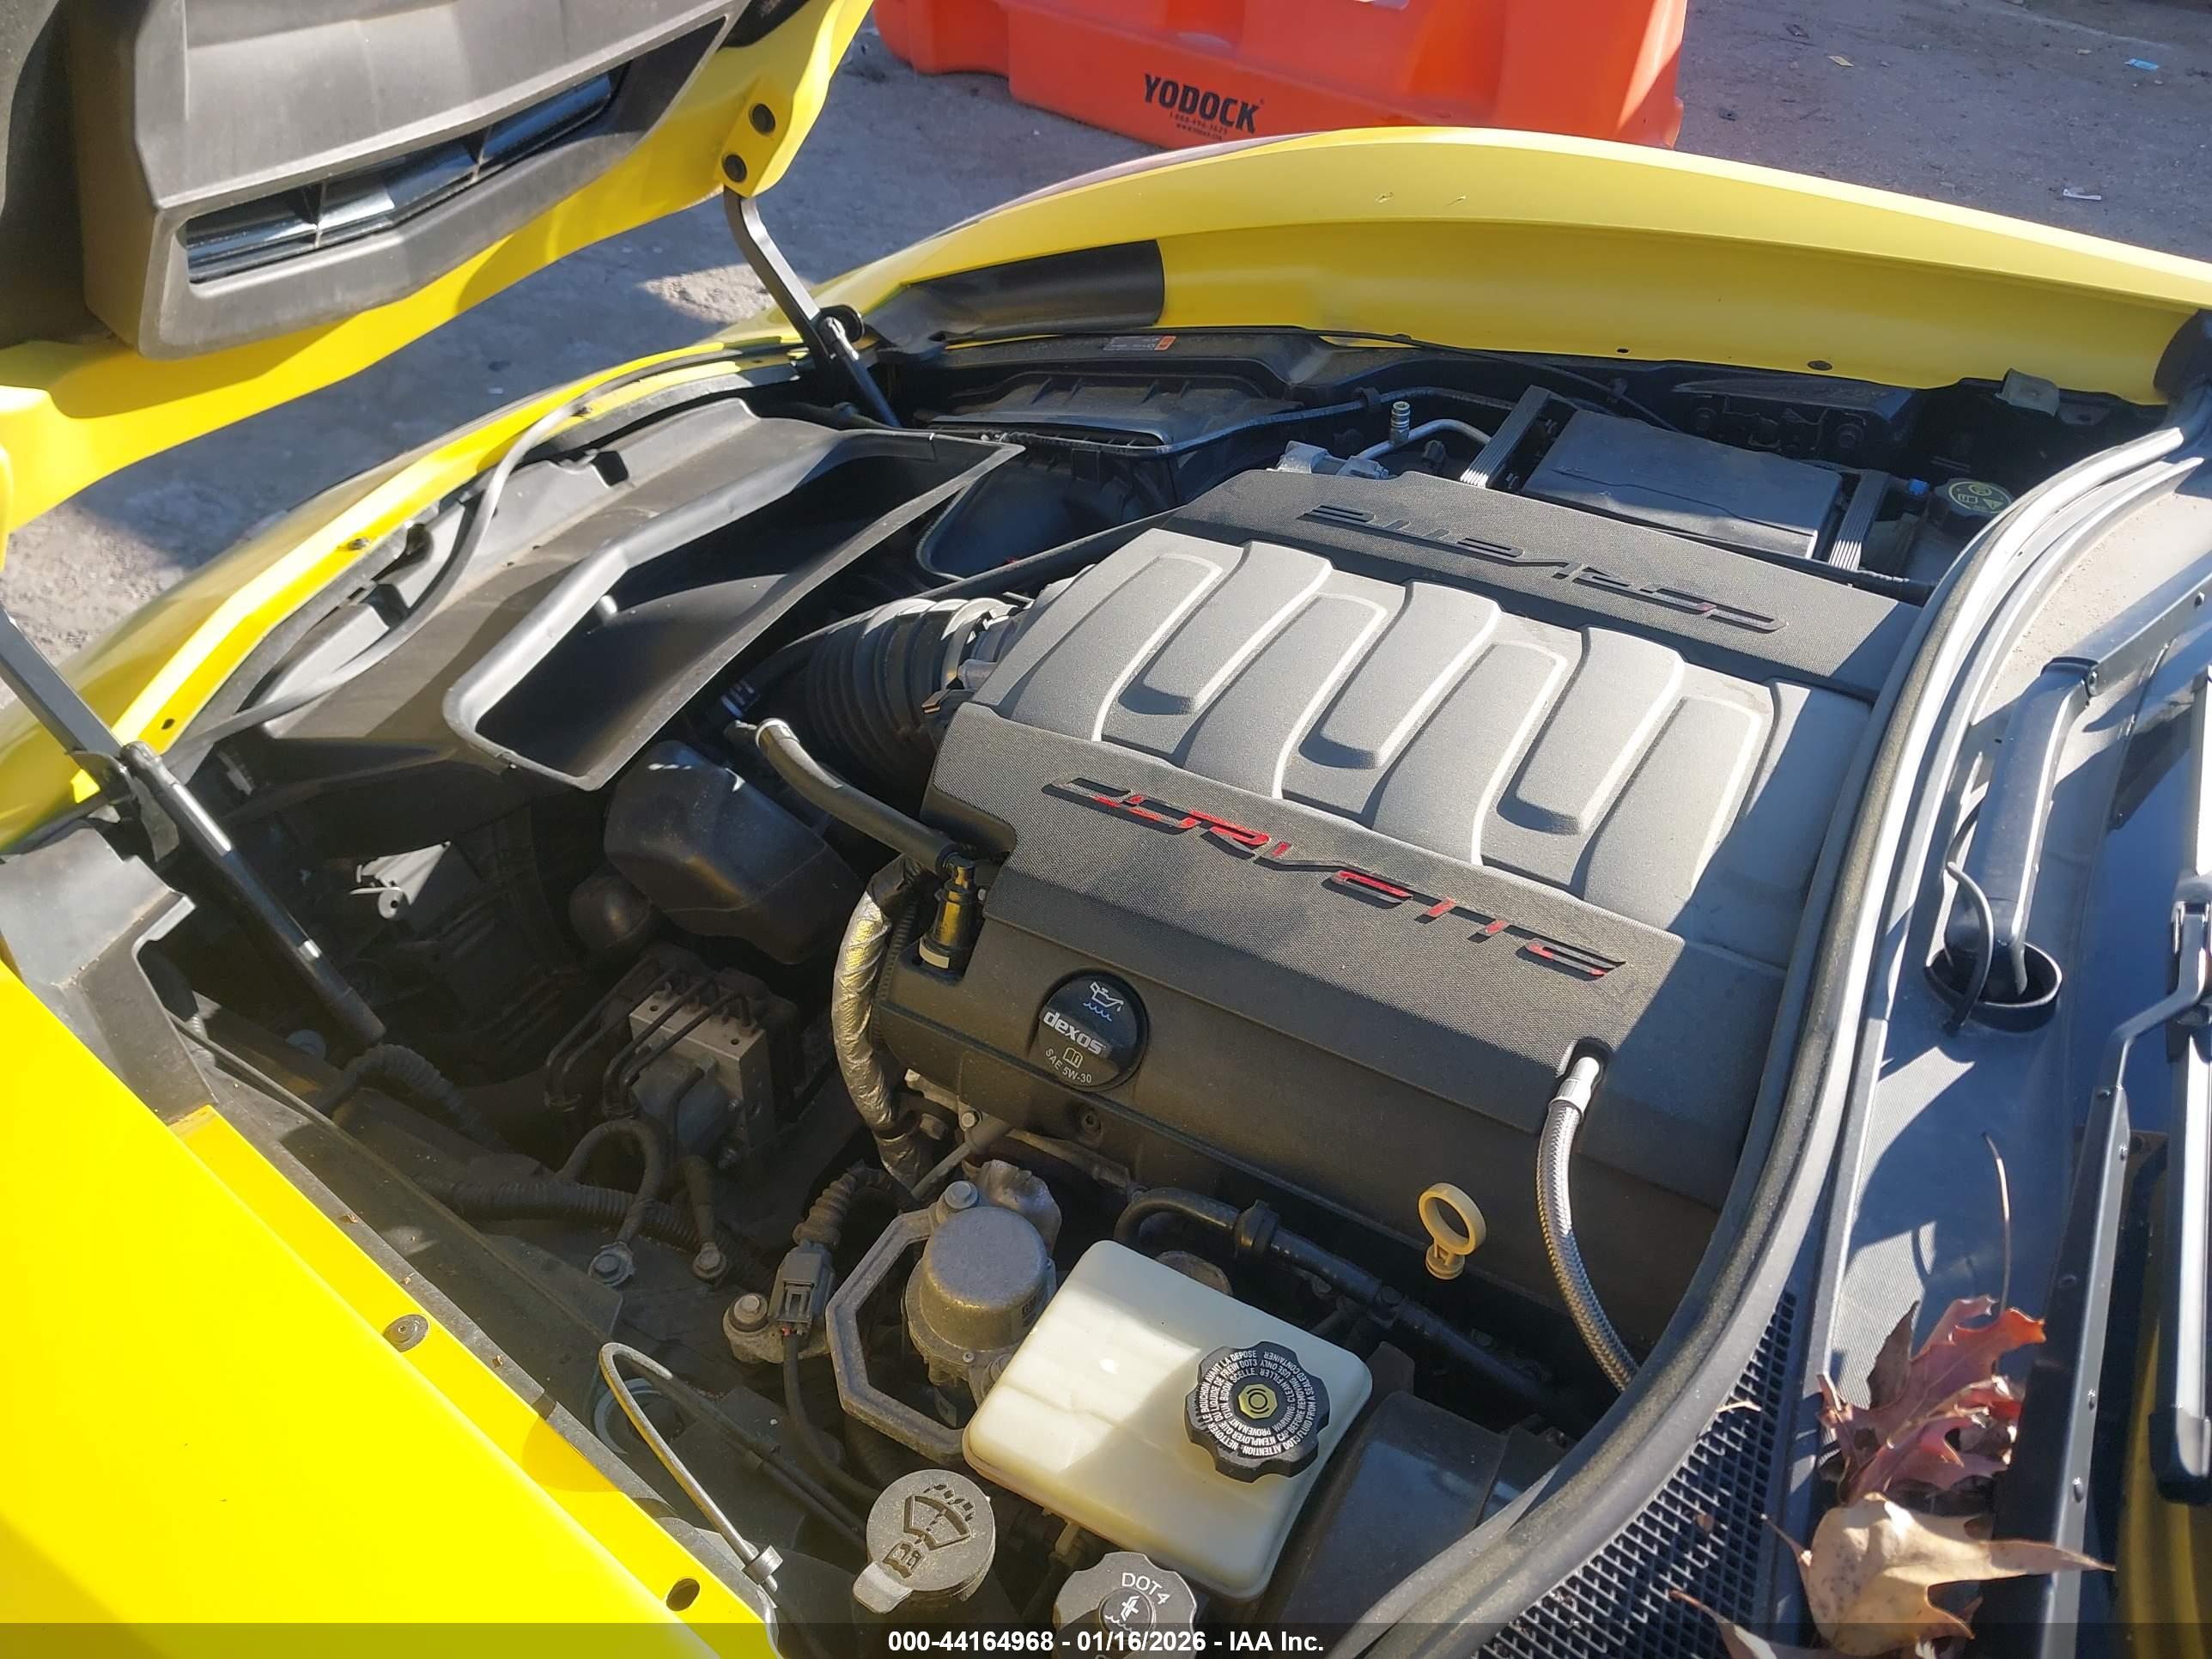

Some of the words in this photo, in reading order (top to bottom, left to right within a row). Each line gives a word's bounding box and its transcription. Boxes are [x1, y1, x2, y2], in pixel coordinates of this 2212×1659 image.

[1145, 74, 1260, 135] YODOCK
[1296, 504, 1789, 635] CORVETTE
[1042, 775, 1626, 977] CORVETTE
[1043, 1012, 1104, 1054] dexos
[1045, 1048, 1063, 1070] SAE
[1061, 1066, 1092, 1084] 5W-30
[1219, 1357, 1231, 1367] LA
[1230, 1350, 1257, 1362] DEPOSE
[1239, 1358, 1258, 1368] DOT3
[1260, 1359, 1278, 1370] ONLY
[1263, 1351, 1300, 1374] CONTAINER
[1205, 1363, 1223, 1383] AVANT
[1220, 1362, 1239, 1380] FREIN
[1259, 1368, 1284, 1384] FILLER
[1277, 1365, 1291, 1378] USE
[1213, 1376, 1225, 1387] DE
[1297, 1371, 1314, 1395] SEALED
[1199, 1382, 1211, 1413] BOUCHON
[1209, 1385, 1221, 1412] LIQUIDE
[1280, 1380, 1296, 1403] CLEAN
[1202, 1413, 1213, 1424] LE
[1212, 1412, 1224, 1422] DU
[1305, 1401, 1316, 1420] FROM
[1218, 1420, 1234, 1435] QUE
[1228, 1418, 1272, 1437] PROVENANT
[1287, 1409, 1305, 1434] BEFORE
[1297, 1419, 1313, 1439] FLUID
[1207, 1422, 1239, 1450] NETTOYER
[1276, 1430, 1290, 1442] CAP
[1282, 1434, 1301, 1450] DOT3
